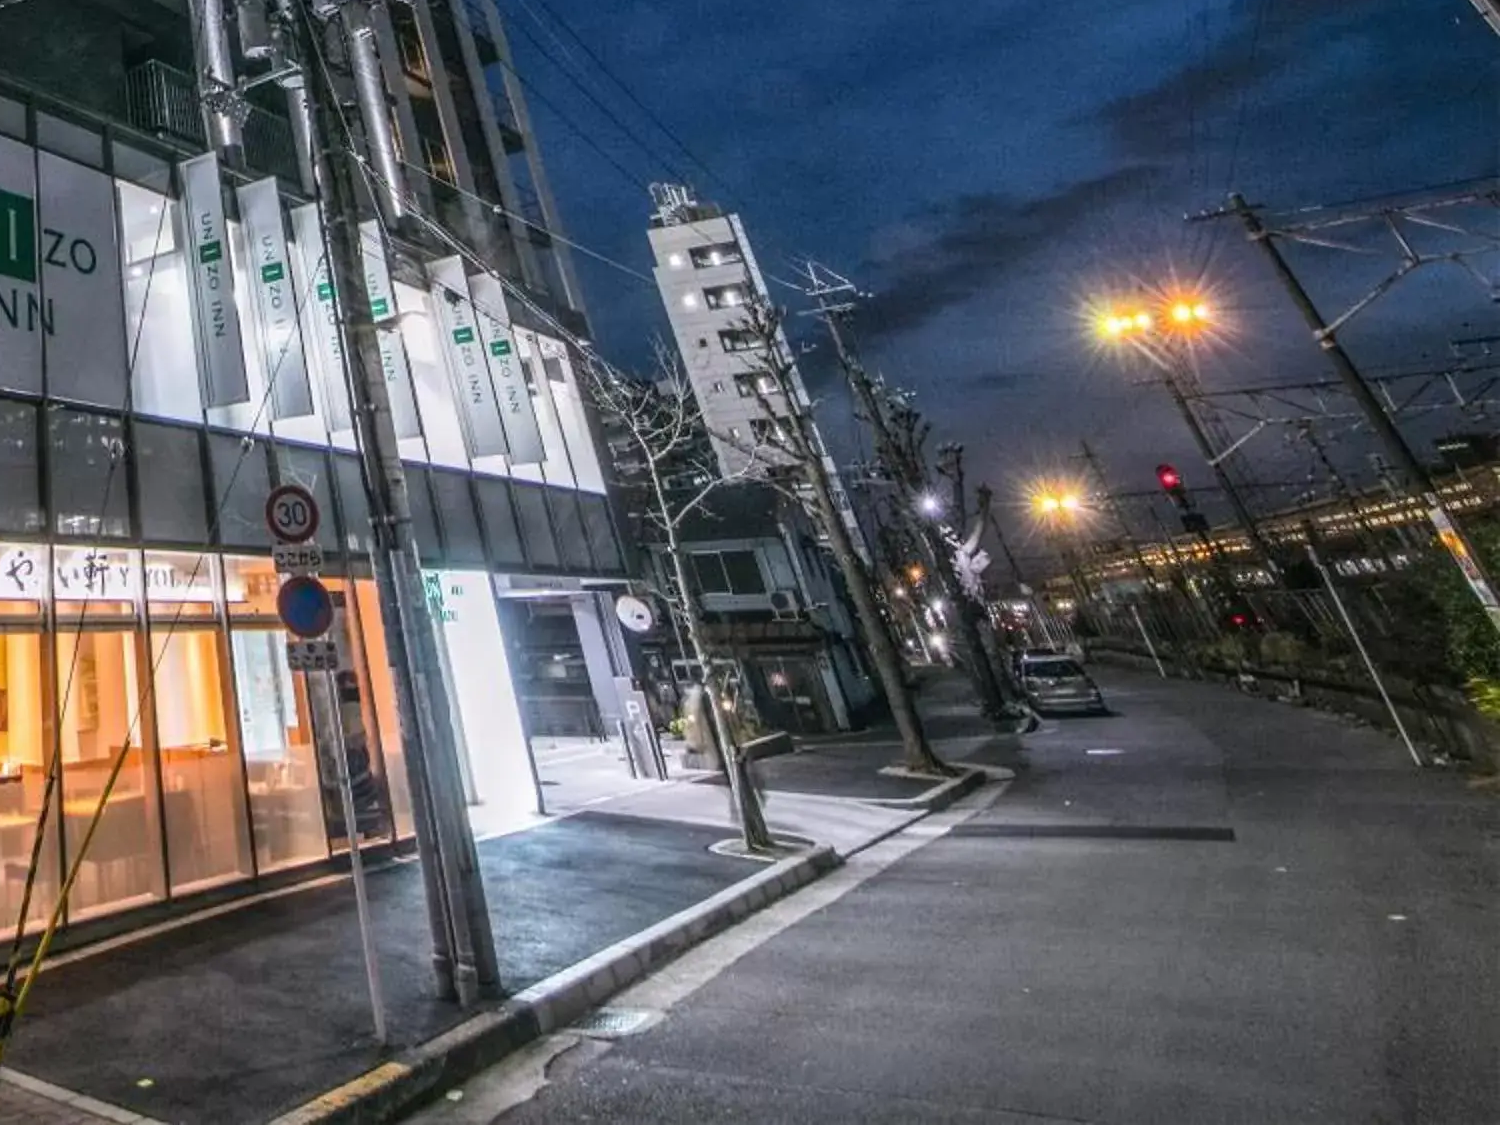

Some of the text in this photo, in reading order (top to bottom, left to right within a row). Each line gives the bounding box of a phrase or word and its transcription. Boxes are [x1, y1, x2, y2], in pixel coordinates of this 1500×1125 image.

[199, 213, 227, 338] UNIZO INN
[261, 235, 284, 309] UNIZO
[277, 501, 307, 528] 30
[6, 550, 110, 596] やい軒
